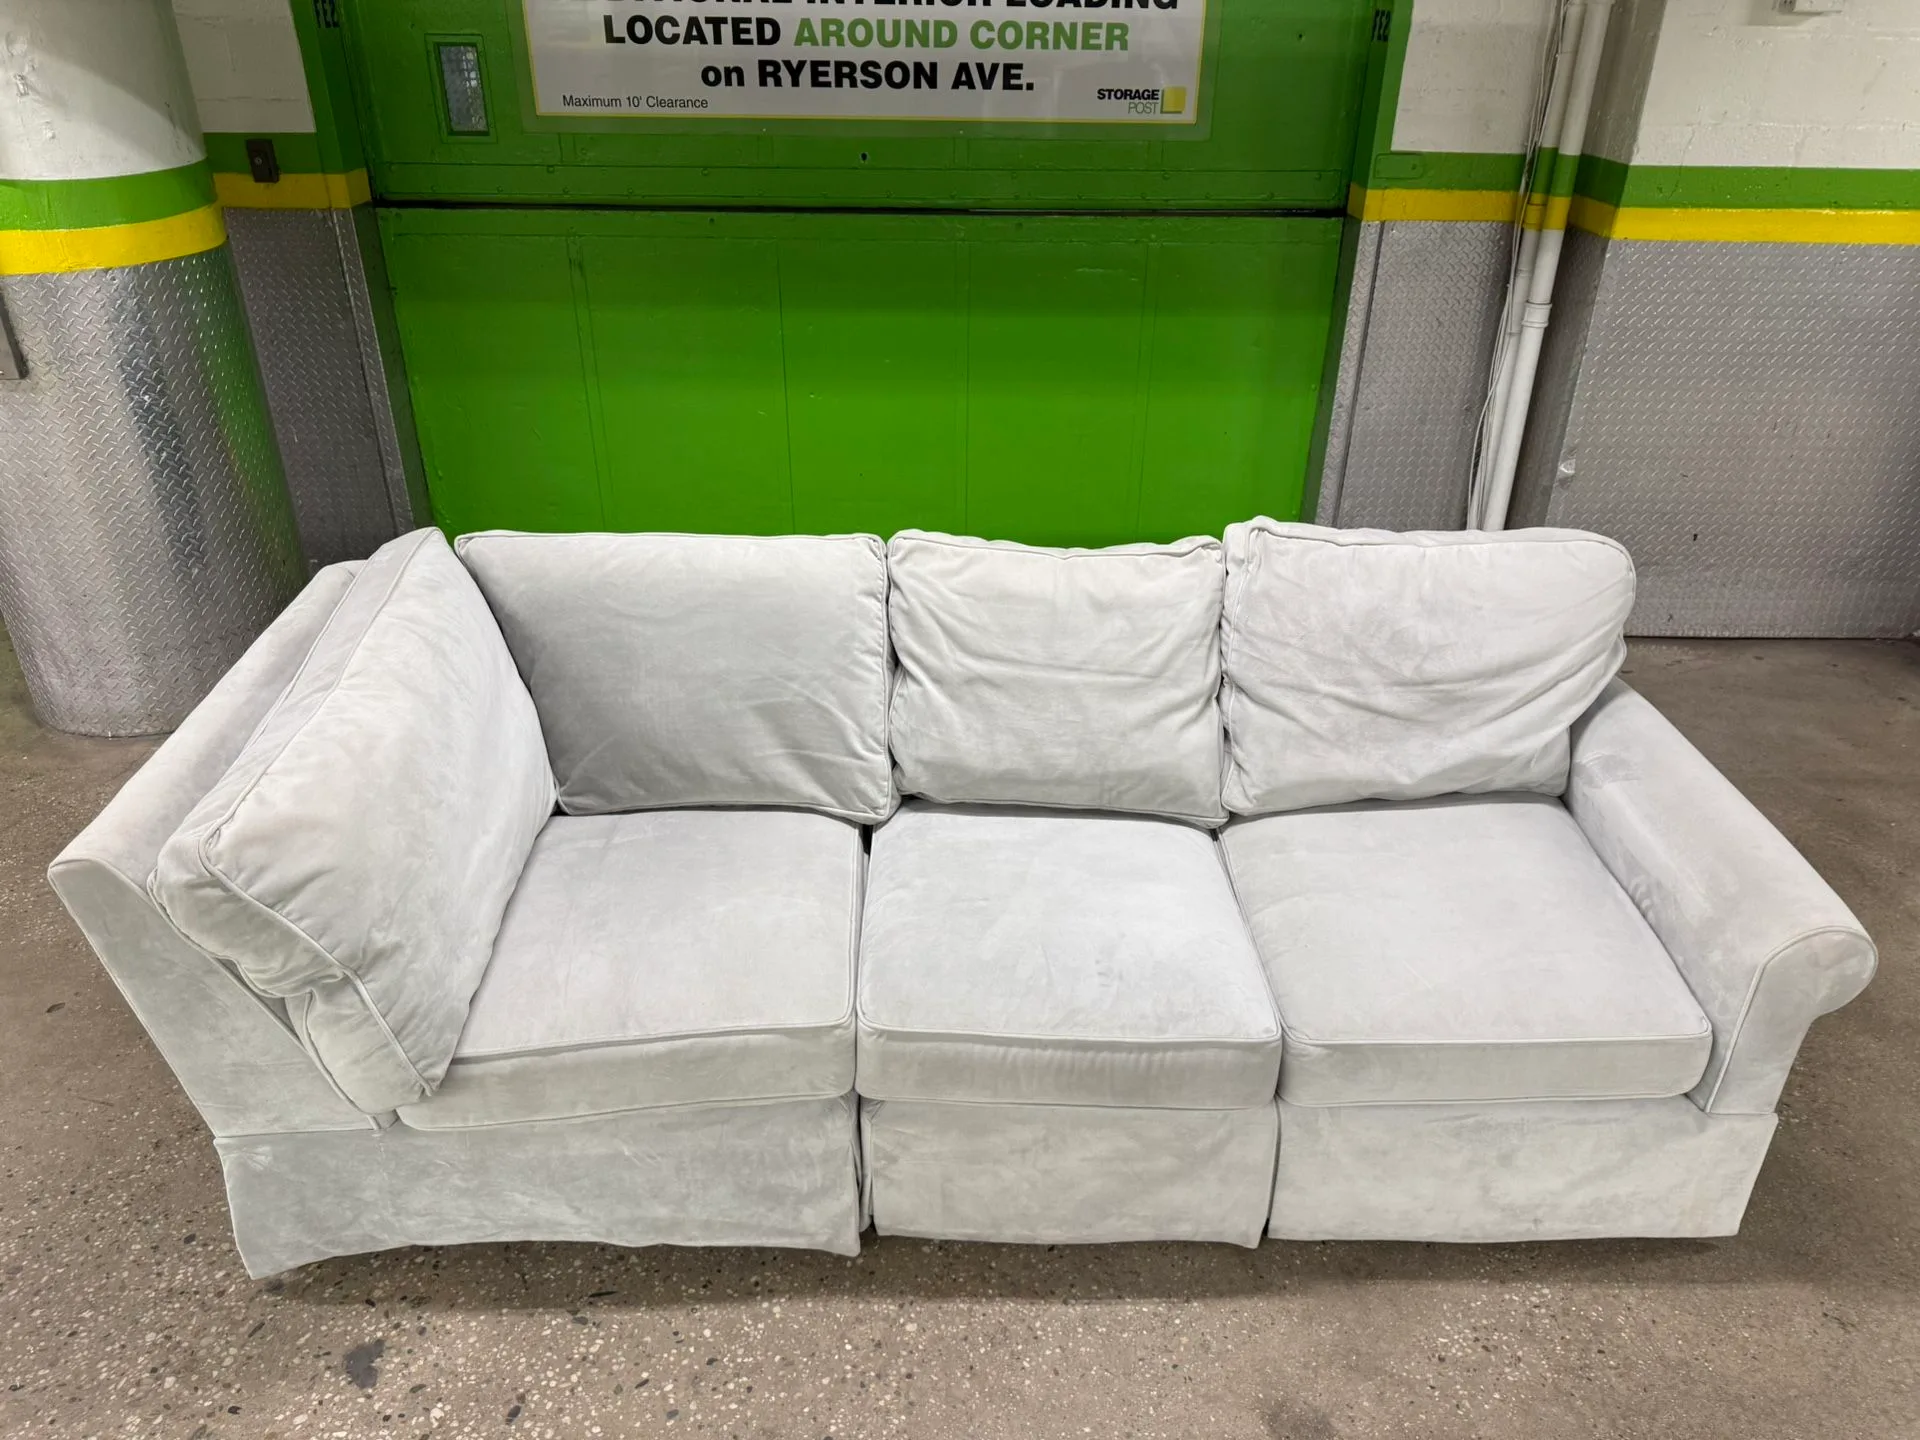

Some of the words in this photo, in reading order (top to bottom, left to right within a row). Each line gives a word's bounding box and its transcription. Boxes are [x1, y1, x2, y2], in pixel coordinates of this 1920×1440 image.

[604, 15, 780, 45] LOCATED
[794, 18, 957, 48] AROUND
[970, 20, 1128, 50] CORNER
[701, 66, 745, 87] on
[758, 60, 937, 89] RYERSON
[951, 62, 1034, 90] AVE.
[1097, 89, 1159, 100] STORAGE
[563, 95, 621, 107] Maximum
[626, 96, 641, 107] 10'
[646, 96, 708, 108] Clearance
[1128, 101, 1159, 114] POST
